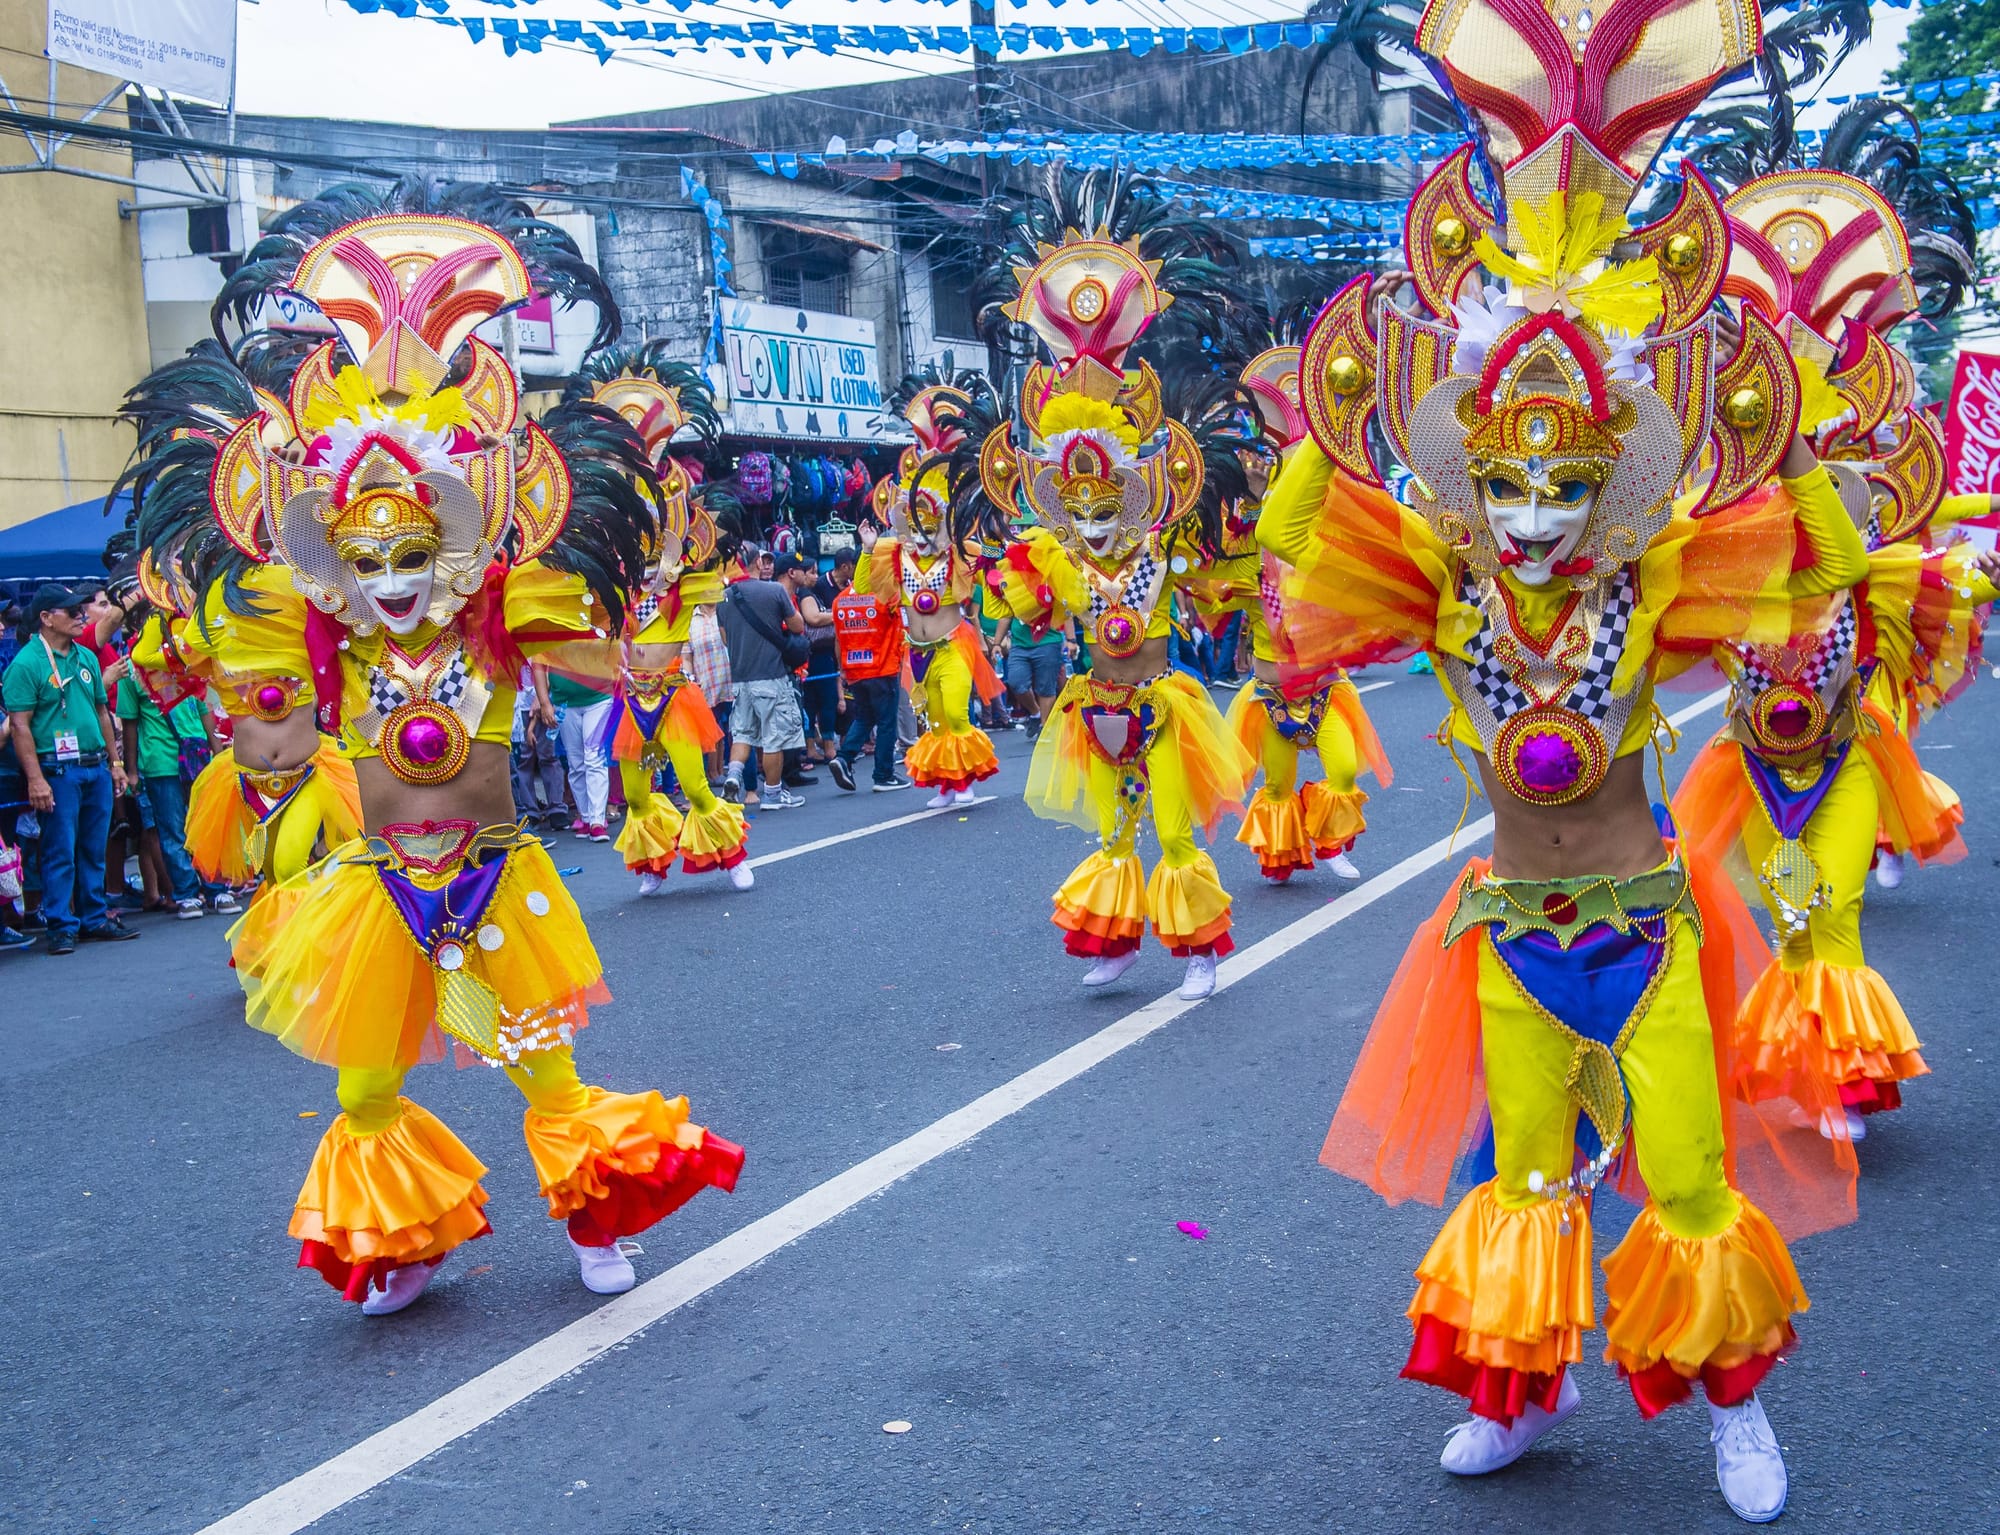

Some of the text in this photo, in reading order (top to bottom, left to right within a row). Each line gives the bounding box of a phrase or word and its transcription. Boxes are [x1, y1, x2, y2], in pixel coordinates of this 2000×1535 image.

[54, 20, 78, 37] Permit
[54, 9, 79, 26] Promo
[80, 19, 96, 32] valid
[97, 23, 111, 36] until
[181, 47, 193, 59] Per
[194, 50, 226, 69] DTI-FTEB
[838, 347, 865, 375] USED
